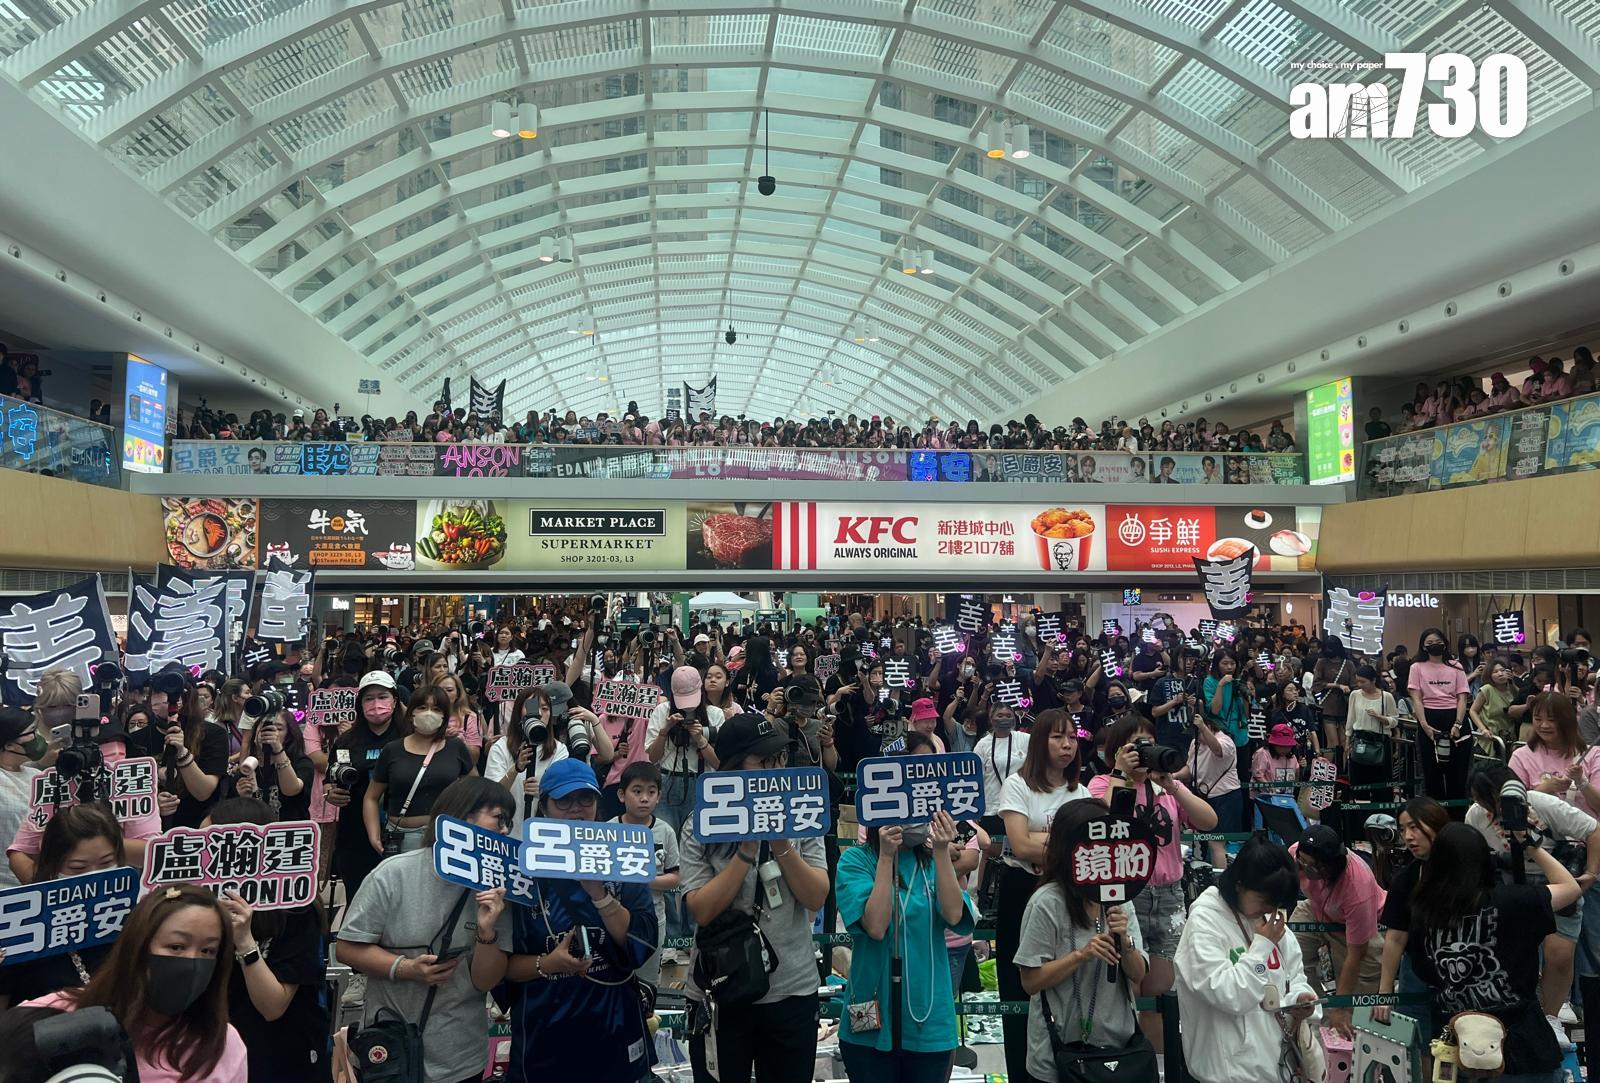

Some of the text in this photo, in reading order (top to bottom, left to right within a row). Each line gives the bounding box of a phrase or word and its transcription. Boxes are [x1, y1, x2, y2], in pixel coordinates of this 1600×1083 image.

[174, 445, 241, 471] 呂爵安
[440, 444, 520, 468] ANSON
[1002, 453, 1063, 474] 呂爵安
[540, 517, 656, 528] MARKET PLACE
[833, 516, 919, 544] KFC
[937, 520, 1015, 536] 新港城中心
[1149, 517, 1200, 546] 爭鮮
[541, 539, 654, 549] SUPERMARKET
[834, 547, 919, 559] ALWAYS ORIGINAL
[560, 555, 634, 564] SHOP 3201-03, L3
[1387, 593, 1440, 608] MaBelle
[310, 690, 356, 712] 盧瀚
[501, 688, 522, 700] ANS
[324, 711, 356, 723] ANSO
[906, 760, 977, 779] EDAN LUI
[748, 774, 822, 793] EDAN LUI
[131, 797, 152, 816] LO
[574, 829, 647, 844] EDAN LUI
[1088, 819, 1130, 840] 日本
[1193, 833, 1225, 841] MOSTown
[476, 832, 510, 857] EDAN
[147, 827, 315, 884] 盧瀚霆
[1074, 842, 1151, 881] 鏡粉
[47, 875, 131, 906] EDAN LUI
[210, 875, 310, 906] NSON LO
[667, 938, 694, 948] MOST
[962, 1003, 1022, 1013] 新港城中心
[1352, 994, 1400, 1006] MOSTown
